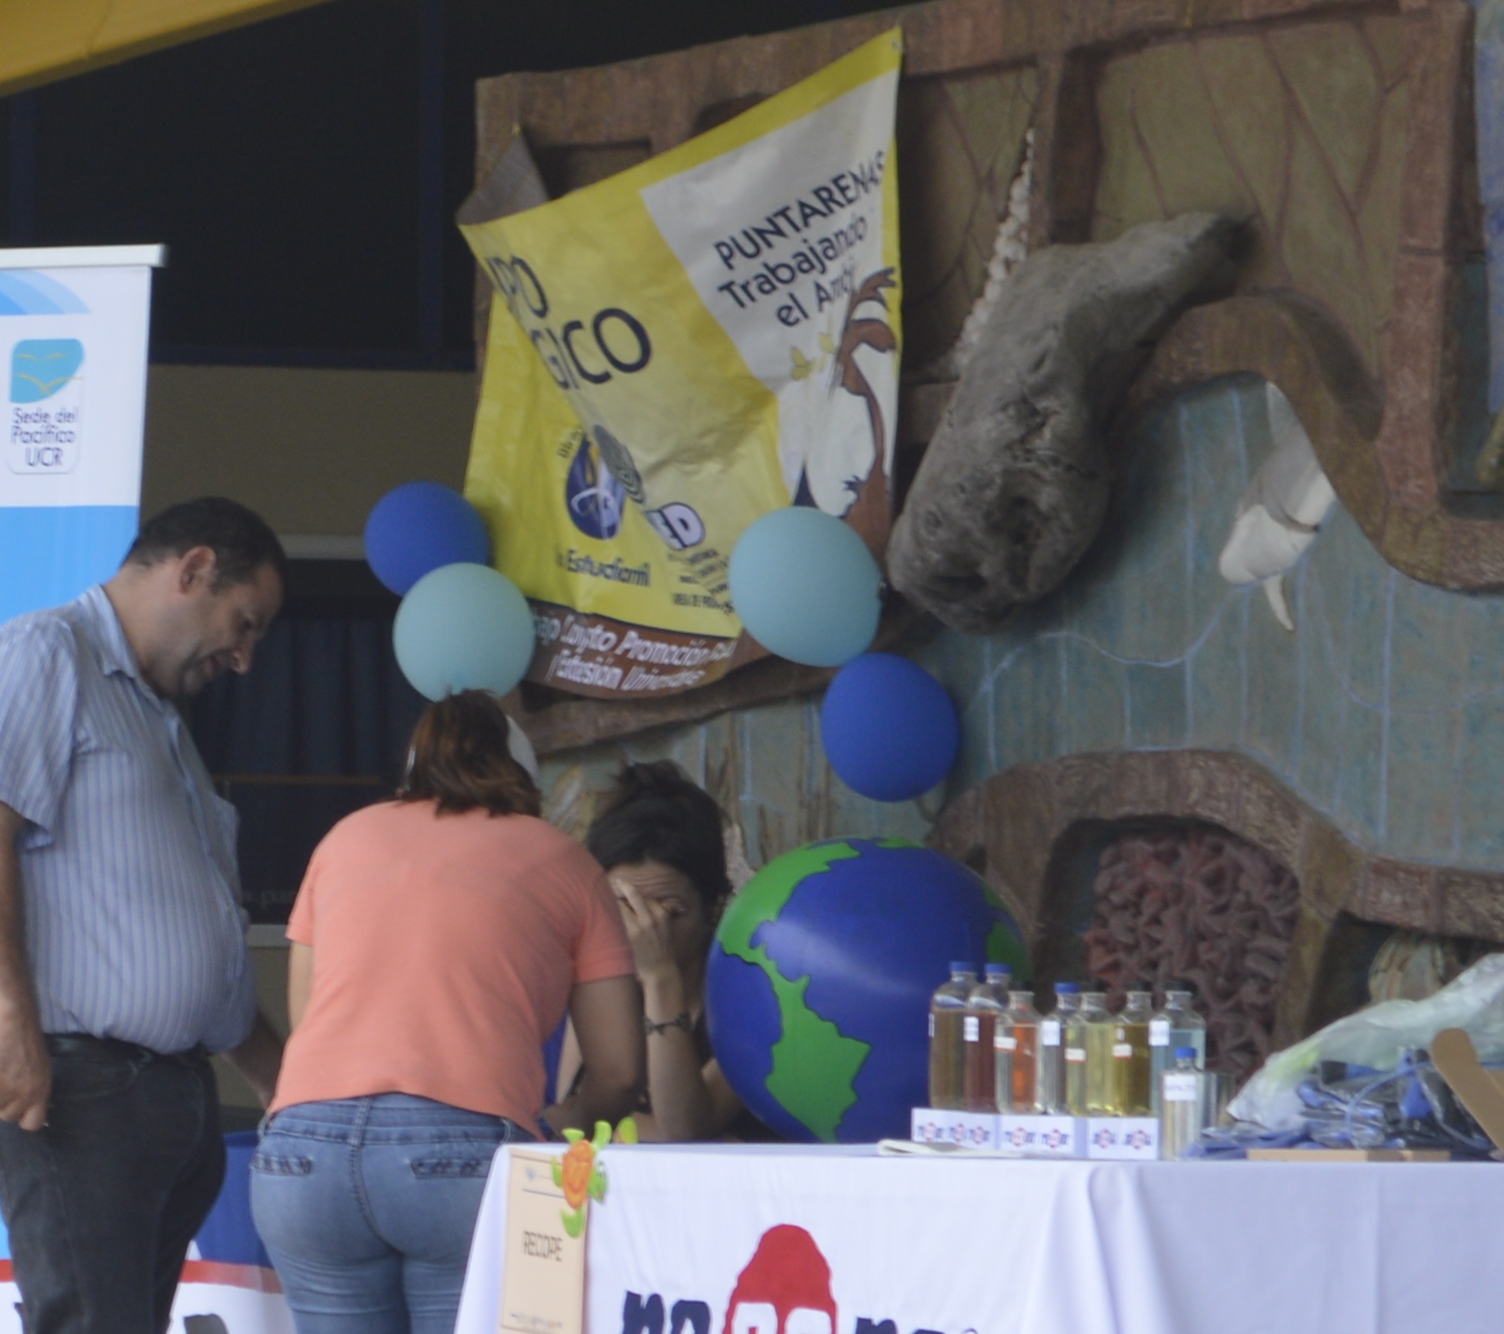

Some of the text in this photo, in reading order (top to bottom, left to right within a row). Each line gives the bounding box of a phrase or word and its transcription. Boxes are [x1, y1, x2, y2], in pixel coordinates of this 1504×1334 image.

[777, 292, 809, 327] el
[13, 407, 79, 424] Sede del
[25, 447, 63, 467] UCR
